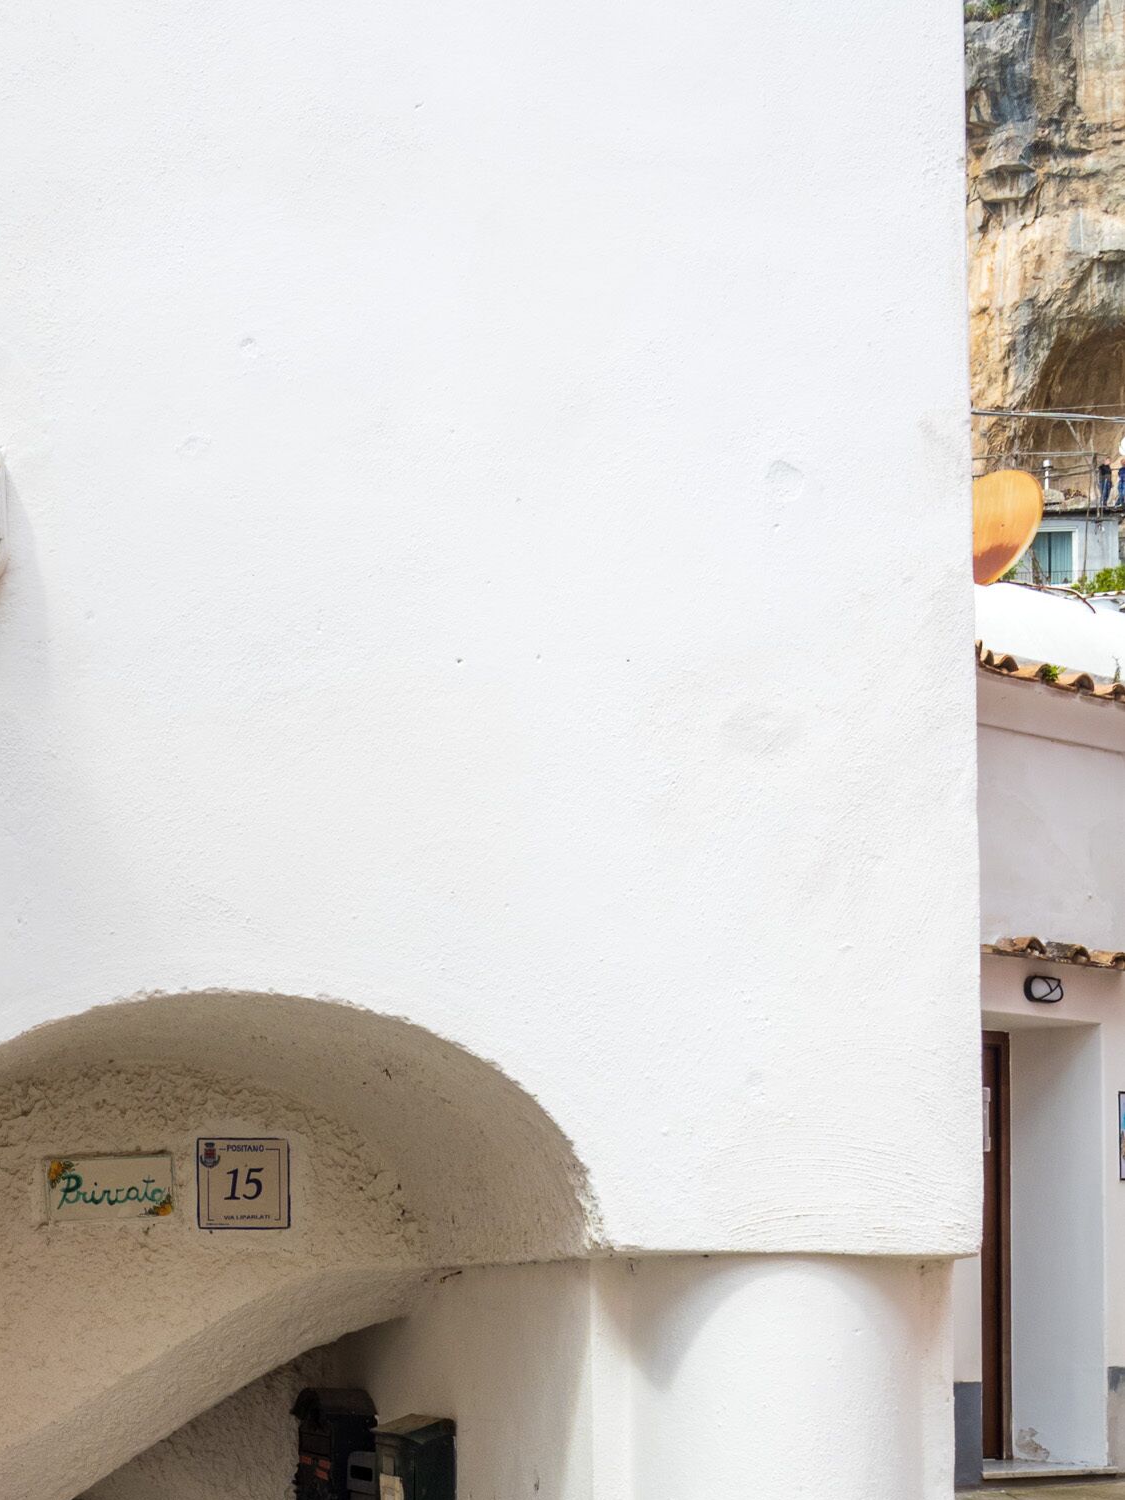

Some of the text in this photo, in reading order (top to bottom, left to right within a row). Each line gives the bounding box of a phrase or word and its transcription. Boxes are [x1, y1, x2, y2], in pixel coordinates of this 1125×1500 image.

[226, 1144, 265, 1152] POSITANO
[56, 1173, 166, 1211] Privato
[223, 1167, 265, 1201] 15
